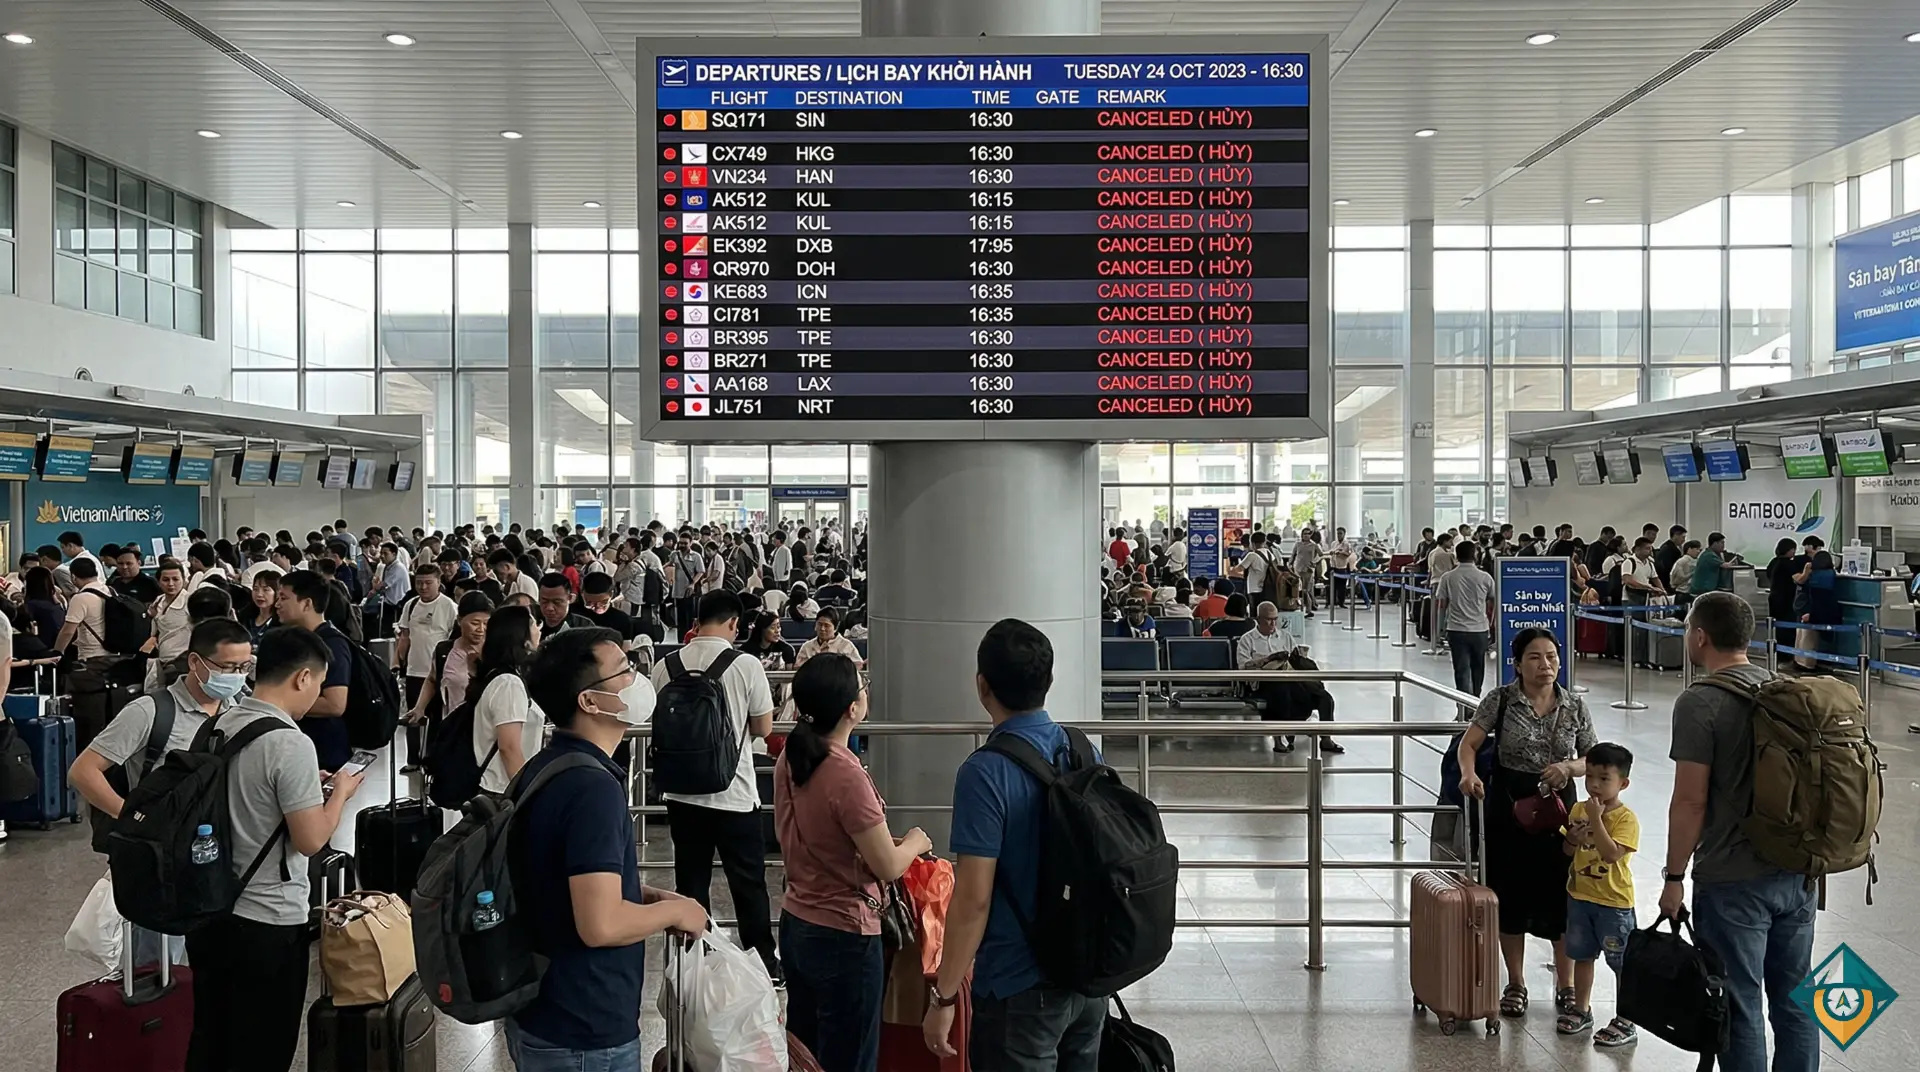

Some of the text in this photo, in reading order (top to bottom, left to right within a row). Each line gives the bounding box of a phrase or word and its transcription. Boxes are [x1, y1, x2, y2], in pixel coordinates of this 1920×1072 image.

[696, 59, 1032, 85] DEPARTURES / LỊCH BAY KHỞI HÀNH
[1063, 63, 1143, 79] TUESDAY
[1146, 63, 1166, 79] 24
[1169, 63, 1205, 79] OCT
[1208, 63, 1247, 79] 2023
[1262, 62, 1304, 78] 16:30
[711, 89, 1167, 105] FLIGHT DESTINATION TIME GATE REMARK
[711, 112, 765, 128] SQ171
[795, 112, 825, 128] SIN
[969, 111, 1013, 127] 16:30
[1097, 110, 1193, 127] CANCELED
[712, 146, 767, 161] CX749
[796, 145, 835, 161] HKG
[969, 145, 1013, 161] 16:30
[1097, 144, 1194, 160] CANCELED
[711, 168, 767, 184] VN234
[796, 169, 833, 184] HAN
[969, 168, 1013, 184] 16:30
[1097, 167, 1194, 183] CANCELED
[712, 191, 767, 207] AK512
[796, 192, 831, 207] KUL
[969, 191, 1013, 207] 16:15
[1097, 191, 1194, 206] CANCELED
[712, 215, 767, 230] AK512
[796, 215, 832, 230] KUL
[969, 215, 1013, 230] 16:15
[1097, 213, 1194, 230] CANCELED
[713, 238, 767, 253] EK392
[796, 238, 833, 253] DXB
[969, 238, 1013, 253] 17:95
[1097, 237, 1194, 253] CANCELED
[713, 261, 770, 277] QR970
[797, 261, 835, 276] DOH
[969, 260, 1013, 276] 16:30
[1097, 260, 1194, 275] CANCELED
[1848, 269, 1871, 289] Sân
[1874, 264, 1897, 283] bay
[713, 284, 768, 299] KE683
[797, 284, 827, 299] ICN
[969, 283, 1014, 299] 16:35
[1097, 283, 1193, 298] CANCELED
[713, 307, 759, 322] CI781
[796, 307, 831, 322] TPE
[969, 306, 1014, 322] 16:35
[1097, 306, 1193, 321] CANCELED
[714, 330, 769, 345] BR395
[796, 330, 832, 345] TPE
[969, 329, 1013, 345] 16:30
[1097, 328, 1194, 344] CANCELED
[714, 353, 766, 368] BR271
[797, 353, 832, 368] TPE
[970, 352, 1013, 368] 16:30
[1097, 352, 1193, 367] CANCELED
[714, 376, 769, 391] AA168
[798, 376, 832, 391] LAX
[969, 375, 1014, 391] 16:30
[1097, 375, 1193, 391] CANCELED
[714, 399, 761, 414] JL751
[798, 399, 834, 414] NRT
[970, 398, 1014, 414] 16:30
[1098, 398, 1193, 413] CANCELED
[61, 505, 150, 523] Vietnam Airlines
[1535, 590, 1552, 602] bay
[1509, 620, 1558, 629] Terminal 1
